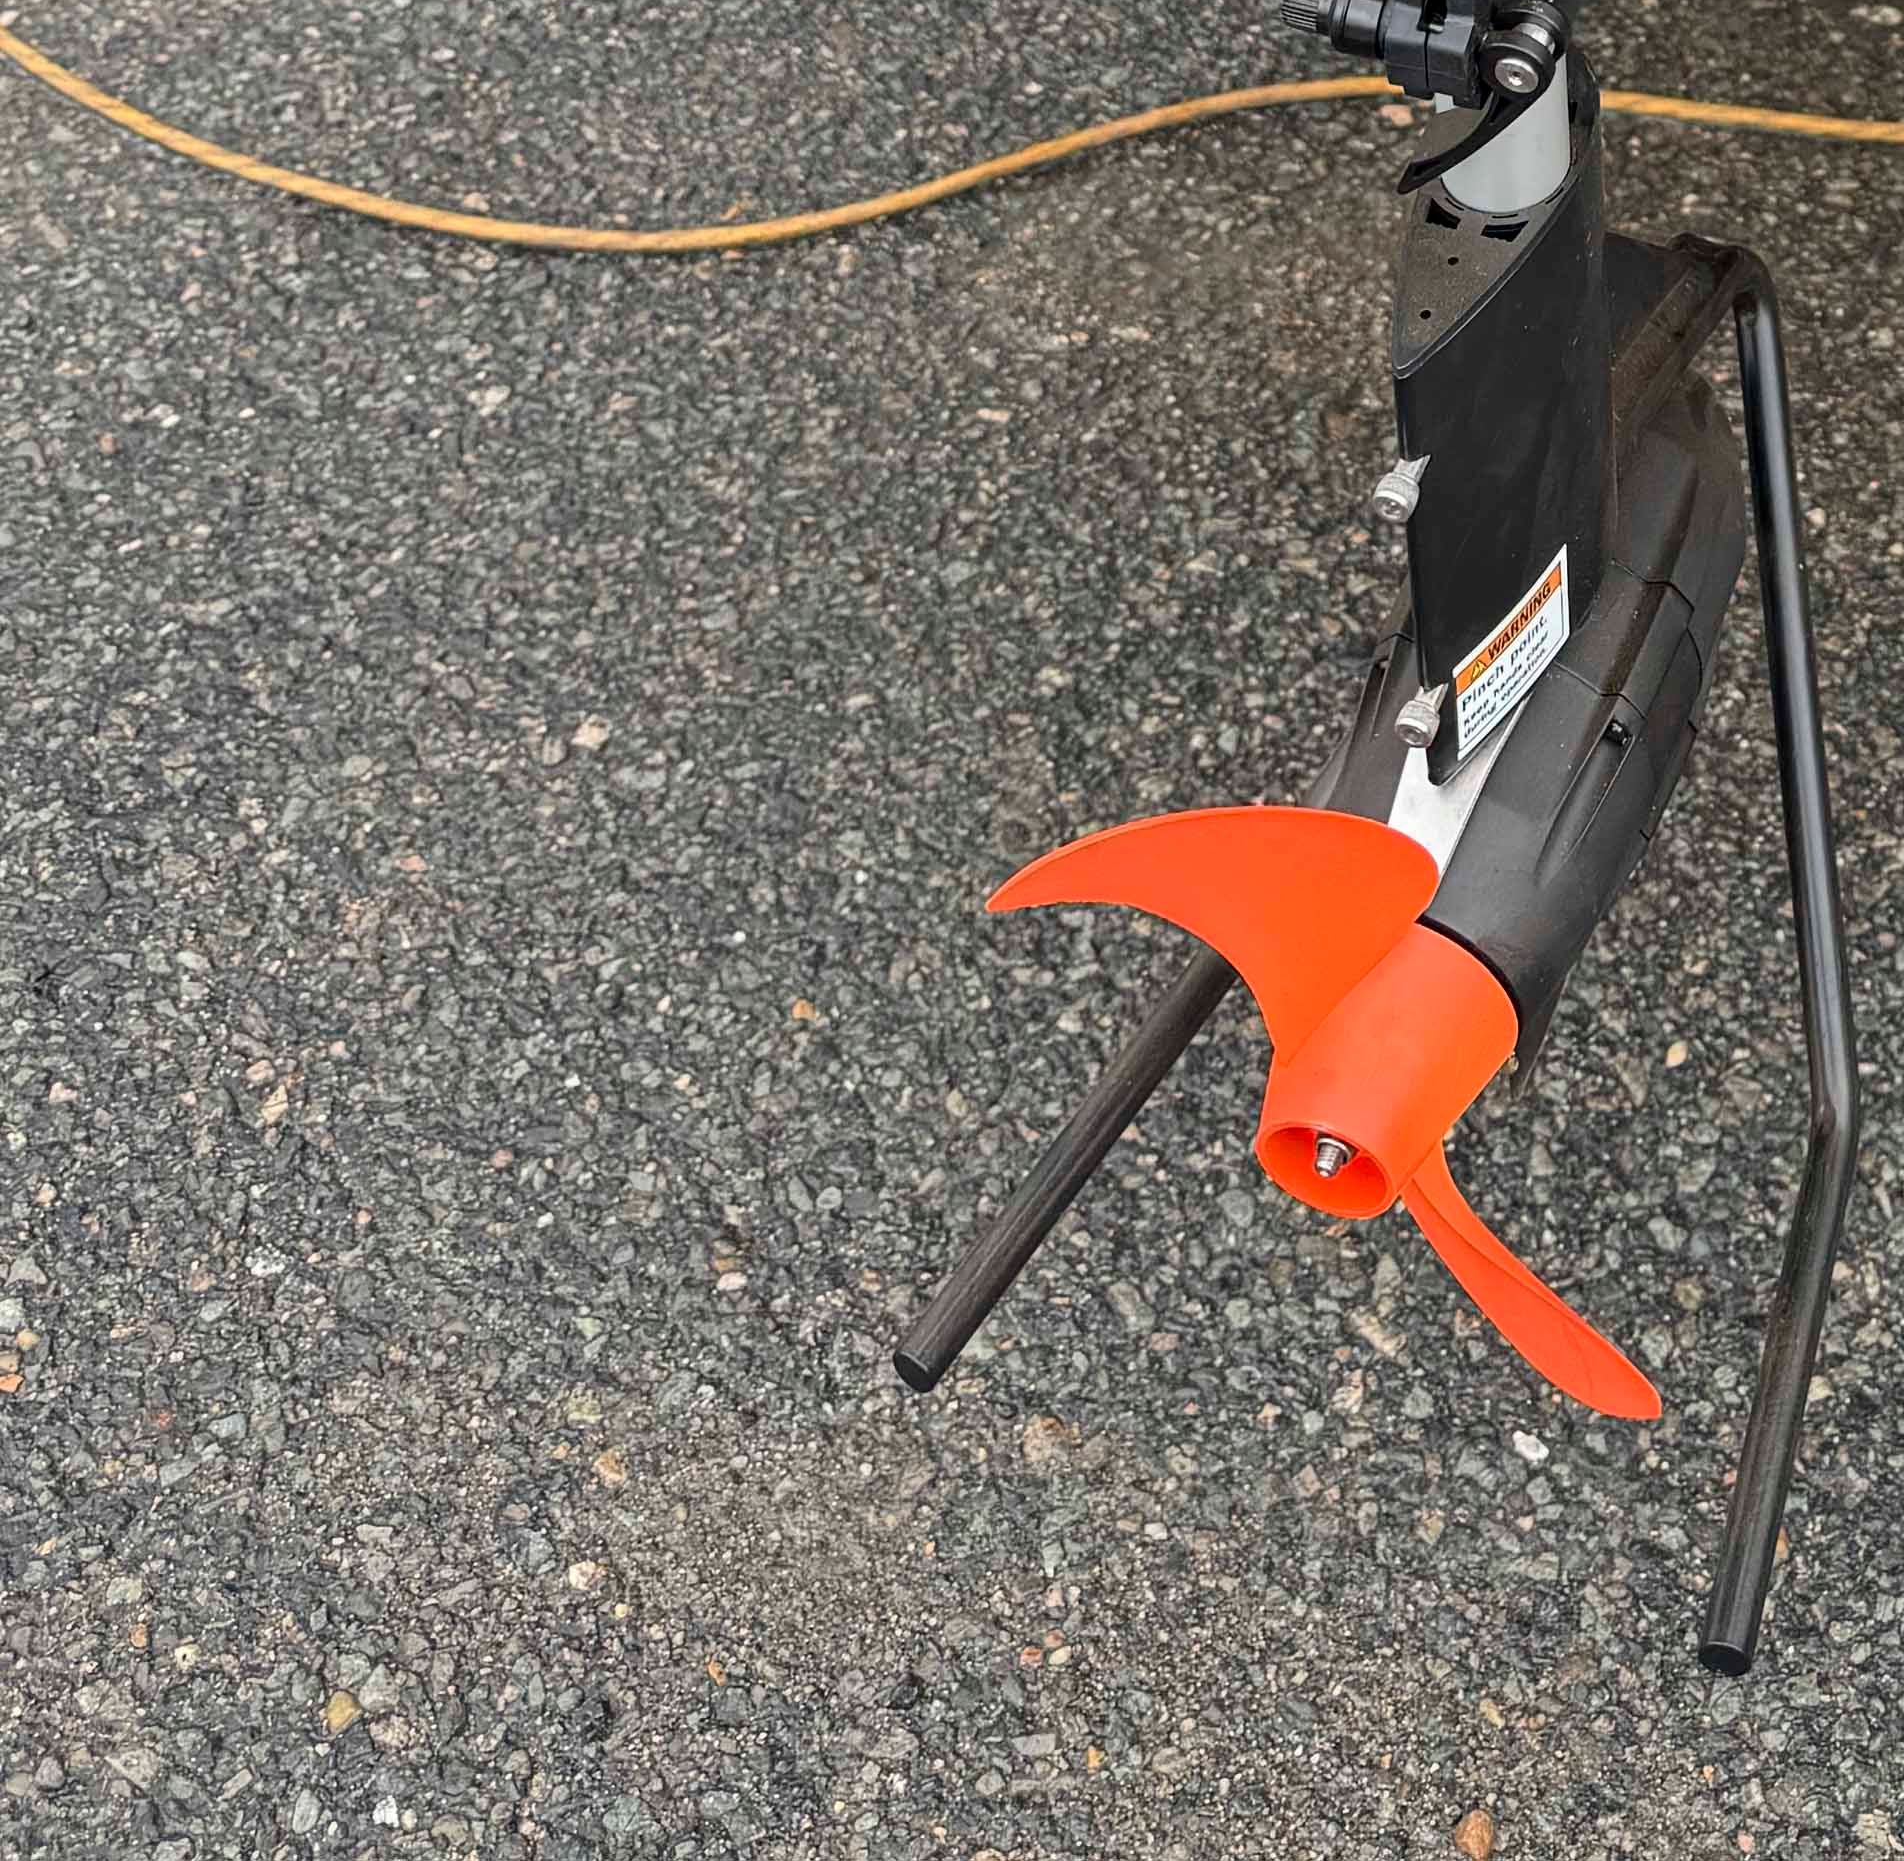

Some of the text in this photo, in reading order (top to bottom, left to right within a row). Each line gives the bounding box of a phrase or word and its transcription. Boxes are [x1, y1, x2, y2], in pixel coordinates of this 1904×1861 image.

[1461, 614, 1548, 713] Pinch point.
[1487, 581, 1552, 660] WARNING
